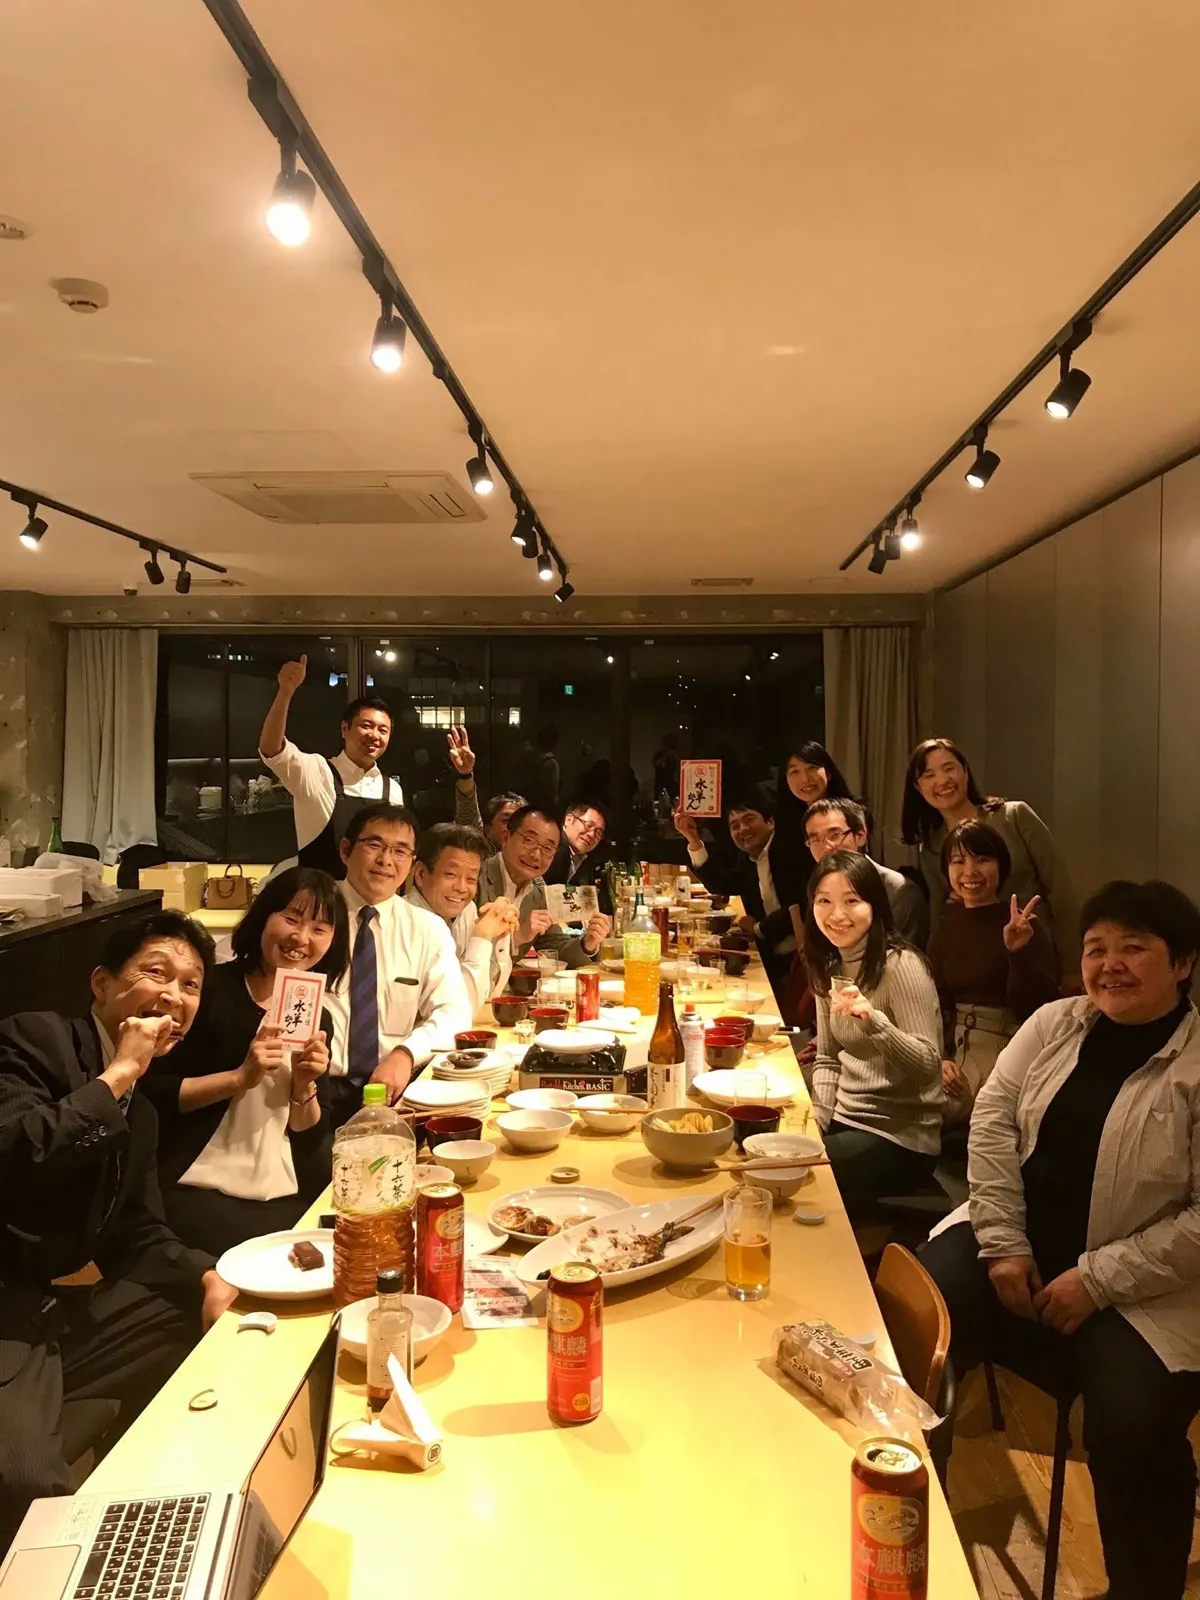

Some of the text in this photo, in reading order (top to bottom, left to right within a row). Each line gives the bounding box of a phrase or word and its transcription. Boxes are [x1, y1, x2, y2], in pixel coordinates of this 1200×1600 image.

[562, 1079, 585, 1090] Kitchen
[391, 1159, 406, 1202] 十六茶
